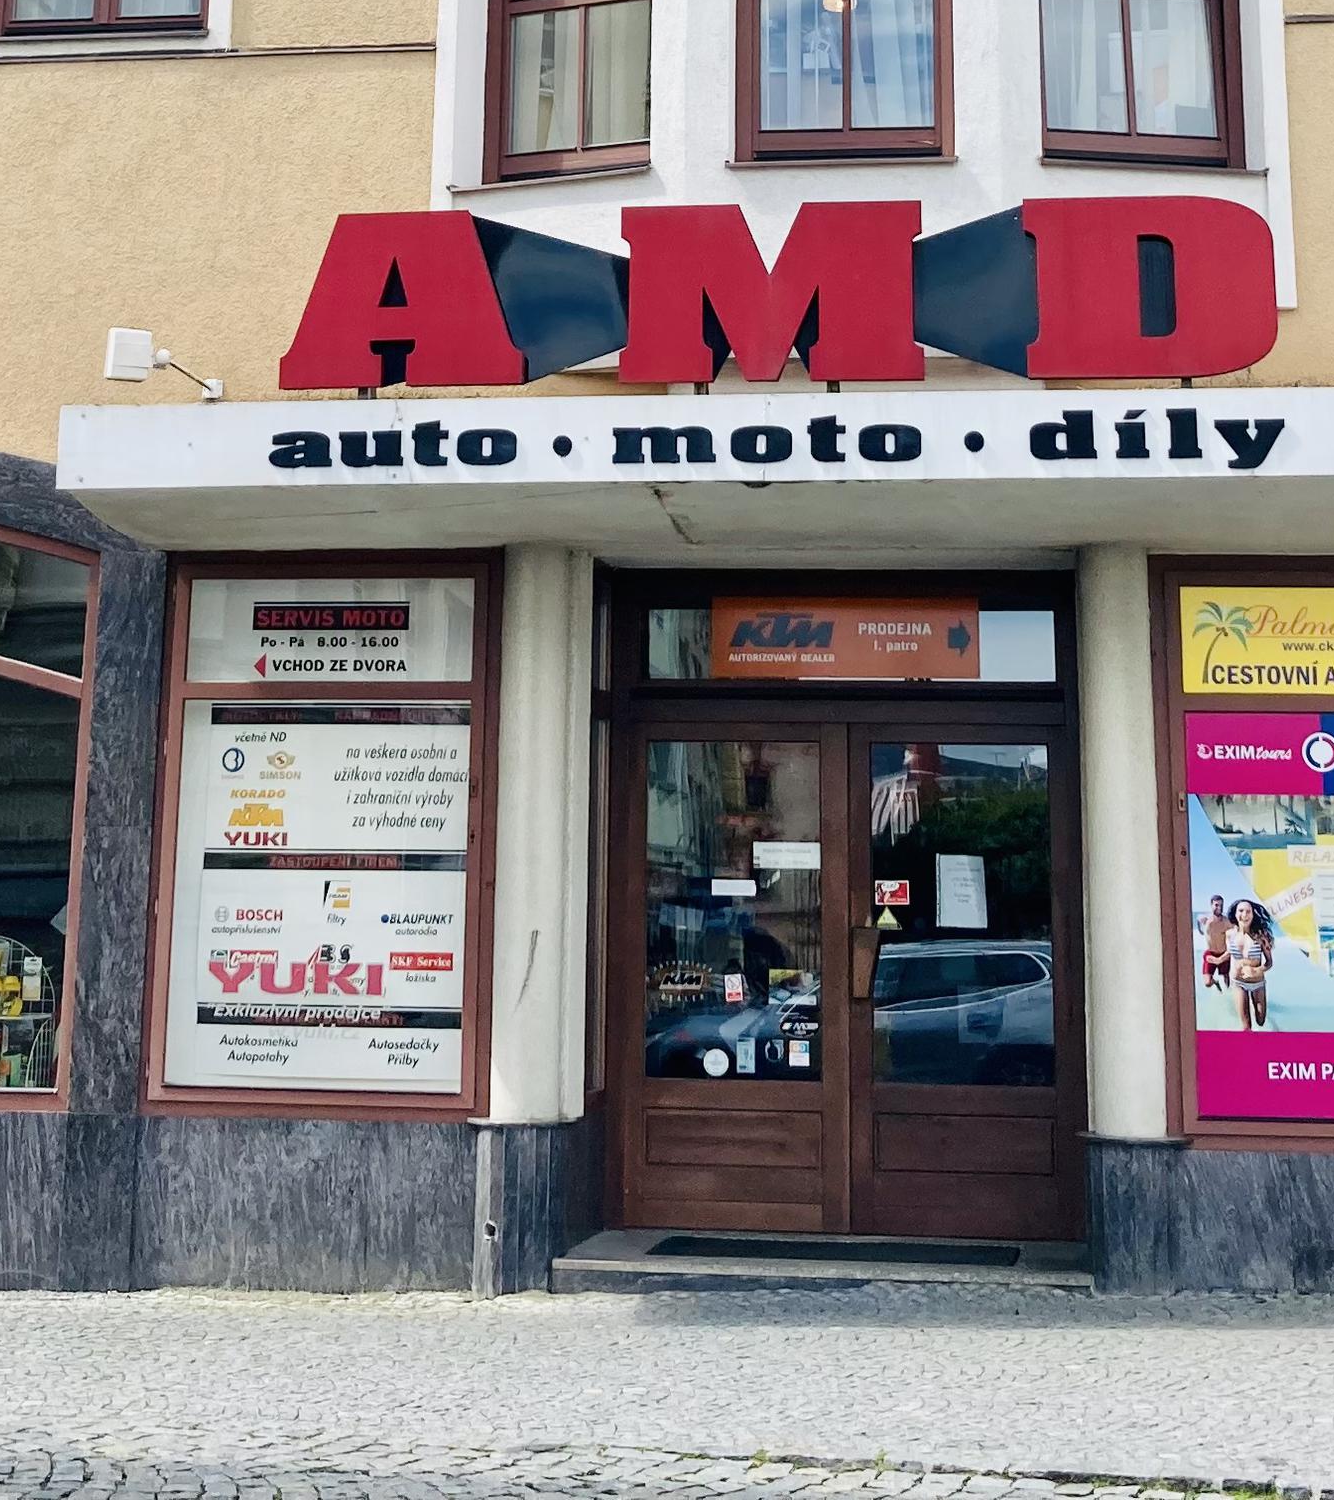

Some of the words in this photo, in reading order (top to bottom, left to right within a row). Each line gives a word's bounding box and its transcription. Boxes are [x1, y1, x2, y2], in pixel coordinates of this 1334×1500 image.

[279, 195, 1279, 389] AMD
[268, 419, 518, 470] auto
[612, 413, 923, 466] moto
[1028, 407, 1286, 469] díly
[257, 610, 334, 627] SERVIS
[343, 610, 405, 627] MOTO
[730, 612, 835, 647] KTM
[858, 622, 932, 636] PRODEJNA
[260, 636, 277, 648] Po
[317, 636, 348, 648] 8.00
[361, 636, 399, 648] 16.00
[886, 641, 918, 653] patro
[272, 659, 325, 672] VCHOD
[329, 659, 349, 672] ZE
[353, 659, 407, 672] DVORA
[800, 653, 835, 663] DEALER
[1211, 660, 1319, 686] CESTOVNÍ
[269, 731, 287, 742] ND
[346, 747, 360, 760] na
[364, 743, 408, 760] veškerá
[410, 743, 447, 760] osobní
[449, 749, 458, 760] a
[259, 771, 302, 781] SIMSON
[385, 765, 425, 783] vozidla
[229, 789, 286, 799] KORADO
[415, 789, 455, 809] výroby
[352, 815, 367, 828] za
[369, 811, 417, 832] výhodné
[420, 816, 447, 832] ceny
[223, 831, 288, 846] YUKI
[1269, 883, 1315, 915] LLNESS
[235, 908, 283, 921] BOSCH
[389, 913, 454, 925] BLAUPUNKT
[390, 954, 413, 967] SKF
[416, 954, 452, 968] Service
[209, 962, 384, 995] YUKI
[219, 1033, 299, 1048] Autokosmetika
[368, 1036, 441, 1052] Autosedačky
[227, 1050, 290, 1066] Autopotahy
[1267, 1062, 1316, 1080] EXIM
